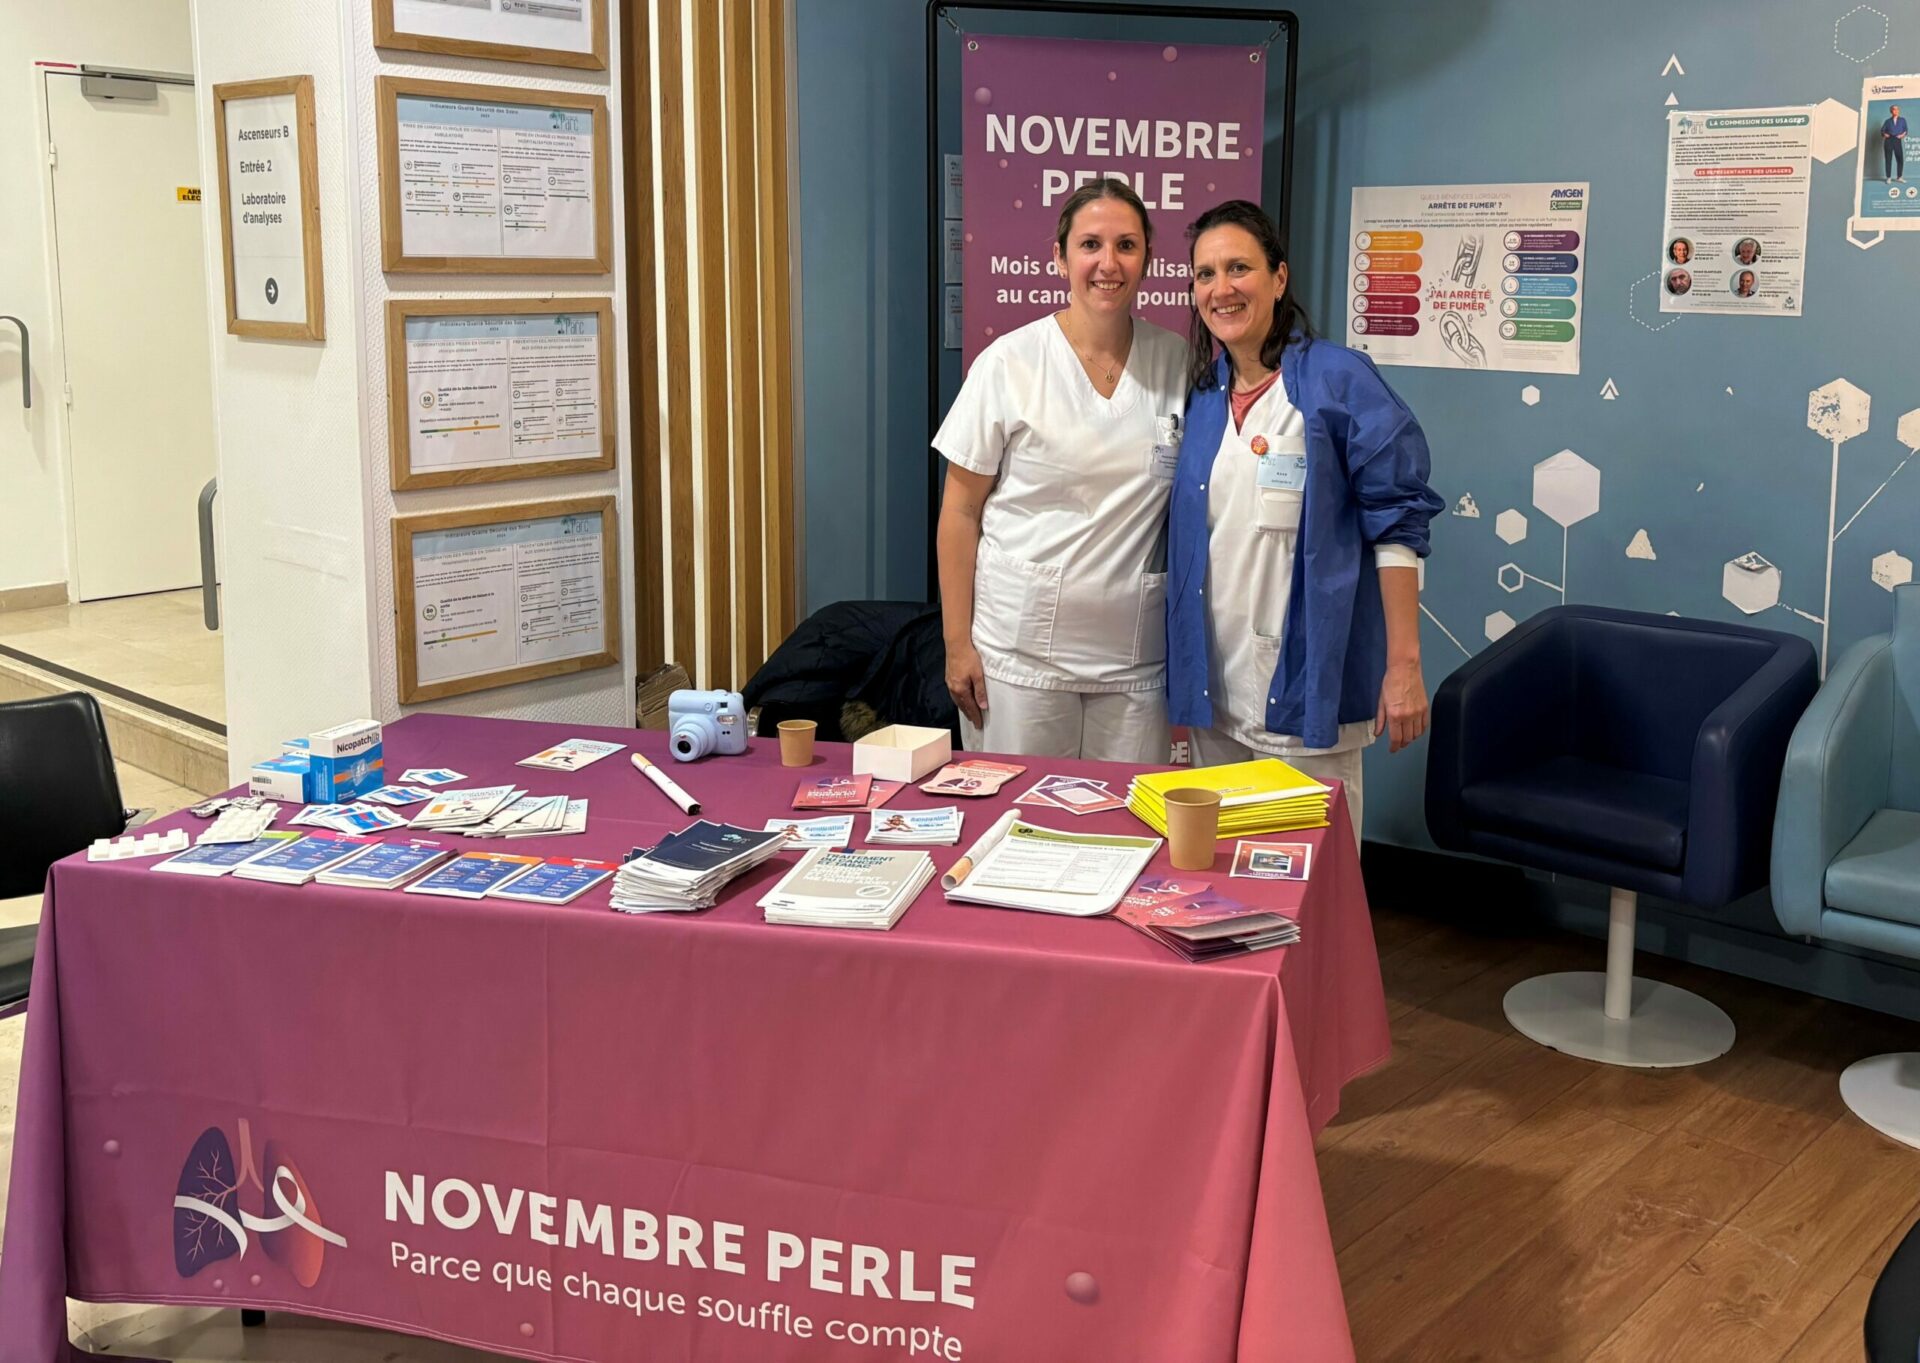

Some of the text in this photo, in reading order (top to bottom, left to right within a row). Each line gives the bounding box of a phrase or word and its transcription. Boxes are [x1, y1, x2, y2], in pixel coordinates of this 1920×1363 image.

[1775, 117, 1806, 125] USAGERS
[238, 125, 290, 142] Ascenseurs B
[985, 113, 1241, 160] NOVEMBRE
[240, 159, 272, 174] Entrée 2
[1042, 169, 1185, 210] PLE
[1551, 188, 1583, 198] AMGEN
[241, 191, 286, 206] Laboratoire
[1428, 201, 1456, 209] ARRÊTE
[242, 211, 283, 226] d'analyses
[991, 255, 1041, 275] Mois
[996, 288, 1196, 310] au can poum
[1428, 287, 1491, 300] J'AI ARRÊTÉ
[1433, 301, 1485, 311] DE FUMER
[336, 731, 380, 754] Nicopatchlib
[826, 853, 896, 862] TRAITEMENT
[833, 861, 873, 869] TABAC
[836, 857, 884, 866] CANCER
[385, 1171, 976, 1310] NOVEMBRE PERLE
[391, 1241, 963, 1362] Parce que chaque souffle compte
